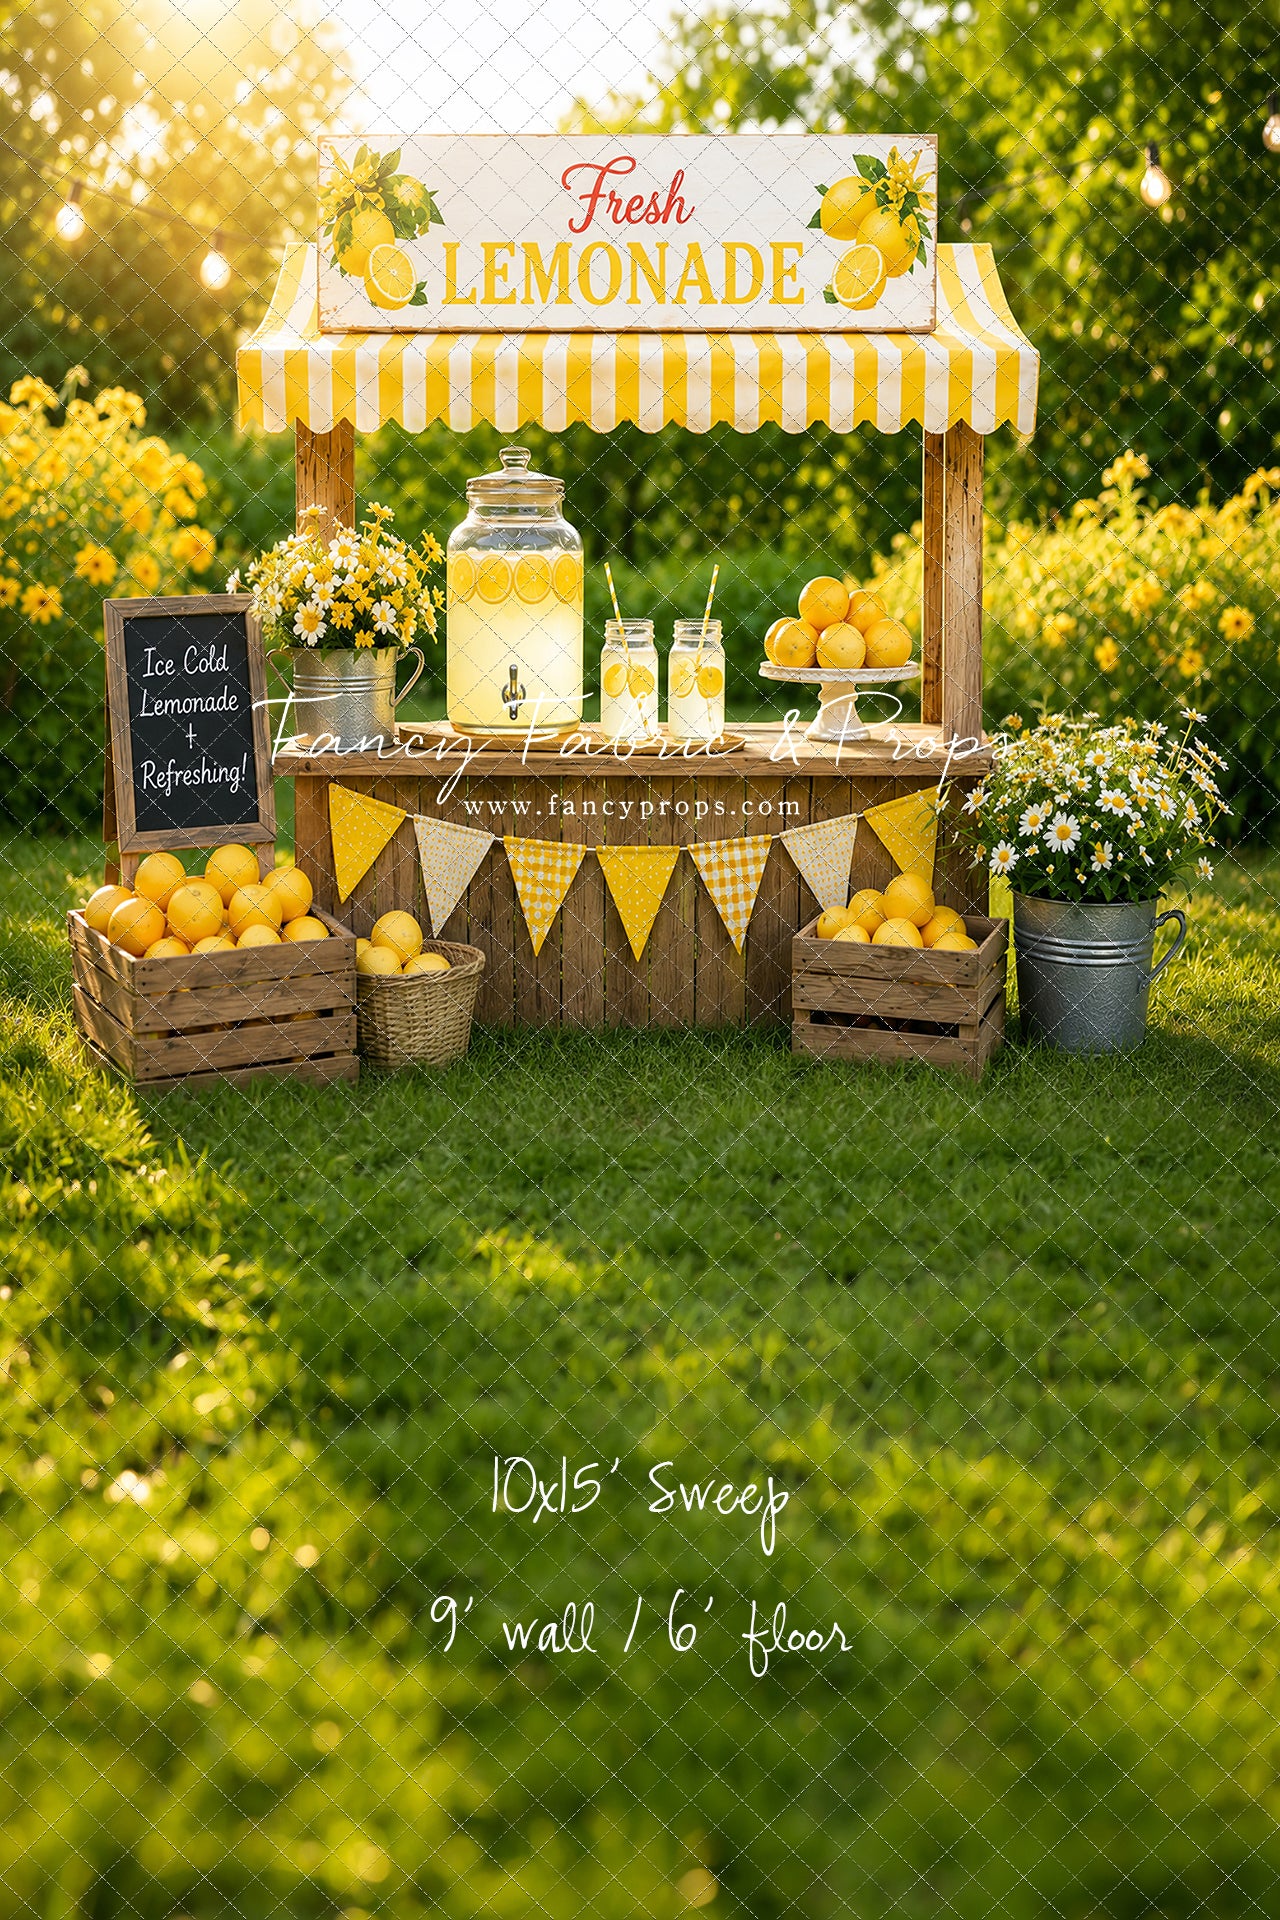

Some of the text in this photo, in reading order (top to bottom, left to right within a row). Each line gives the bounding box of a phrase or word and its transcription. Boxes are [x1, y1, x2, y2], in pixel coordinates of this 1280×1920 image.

[561, 155, 695, 233] Fresh
[441, 241, 805, 306] LEMONADE
[142, 644, 230, 678] Ice Cold
[140, 684, 240, 717] Lemonade
[140, 752, 248, 797] Refreshing!
